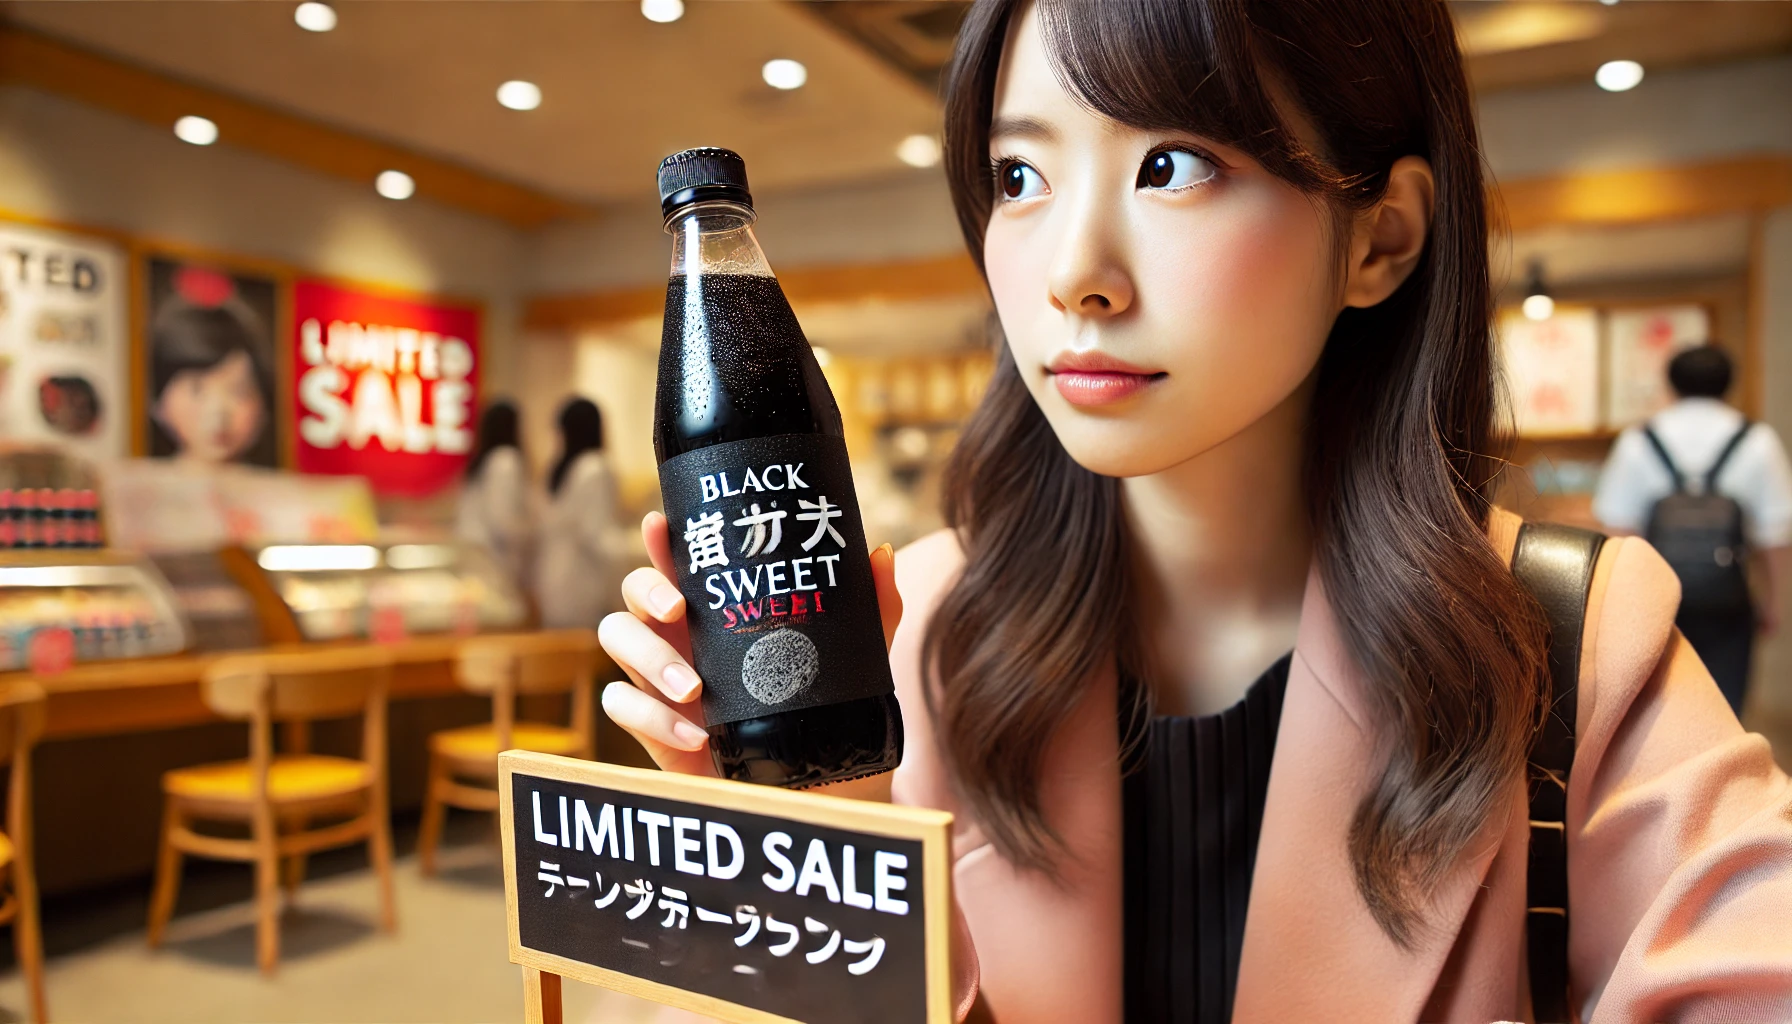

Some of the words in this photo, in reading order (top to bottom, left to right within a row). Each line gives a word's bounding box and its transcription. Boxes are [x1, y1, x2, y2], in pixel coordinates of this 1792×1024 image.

[301, 318, 473, 379] LIMITED
[300, 366, 473, 455] SALE
[700, 463, 809, 503] BLACK
[705, 554, 840, 610] SWEET
[532, 790, 744, 880] LIMITED
[762, 831, 909, 915] SALE
